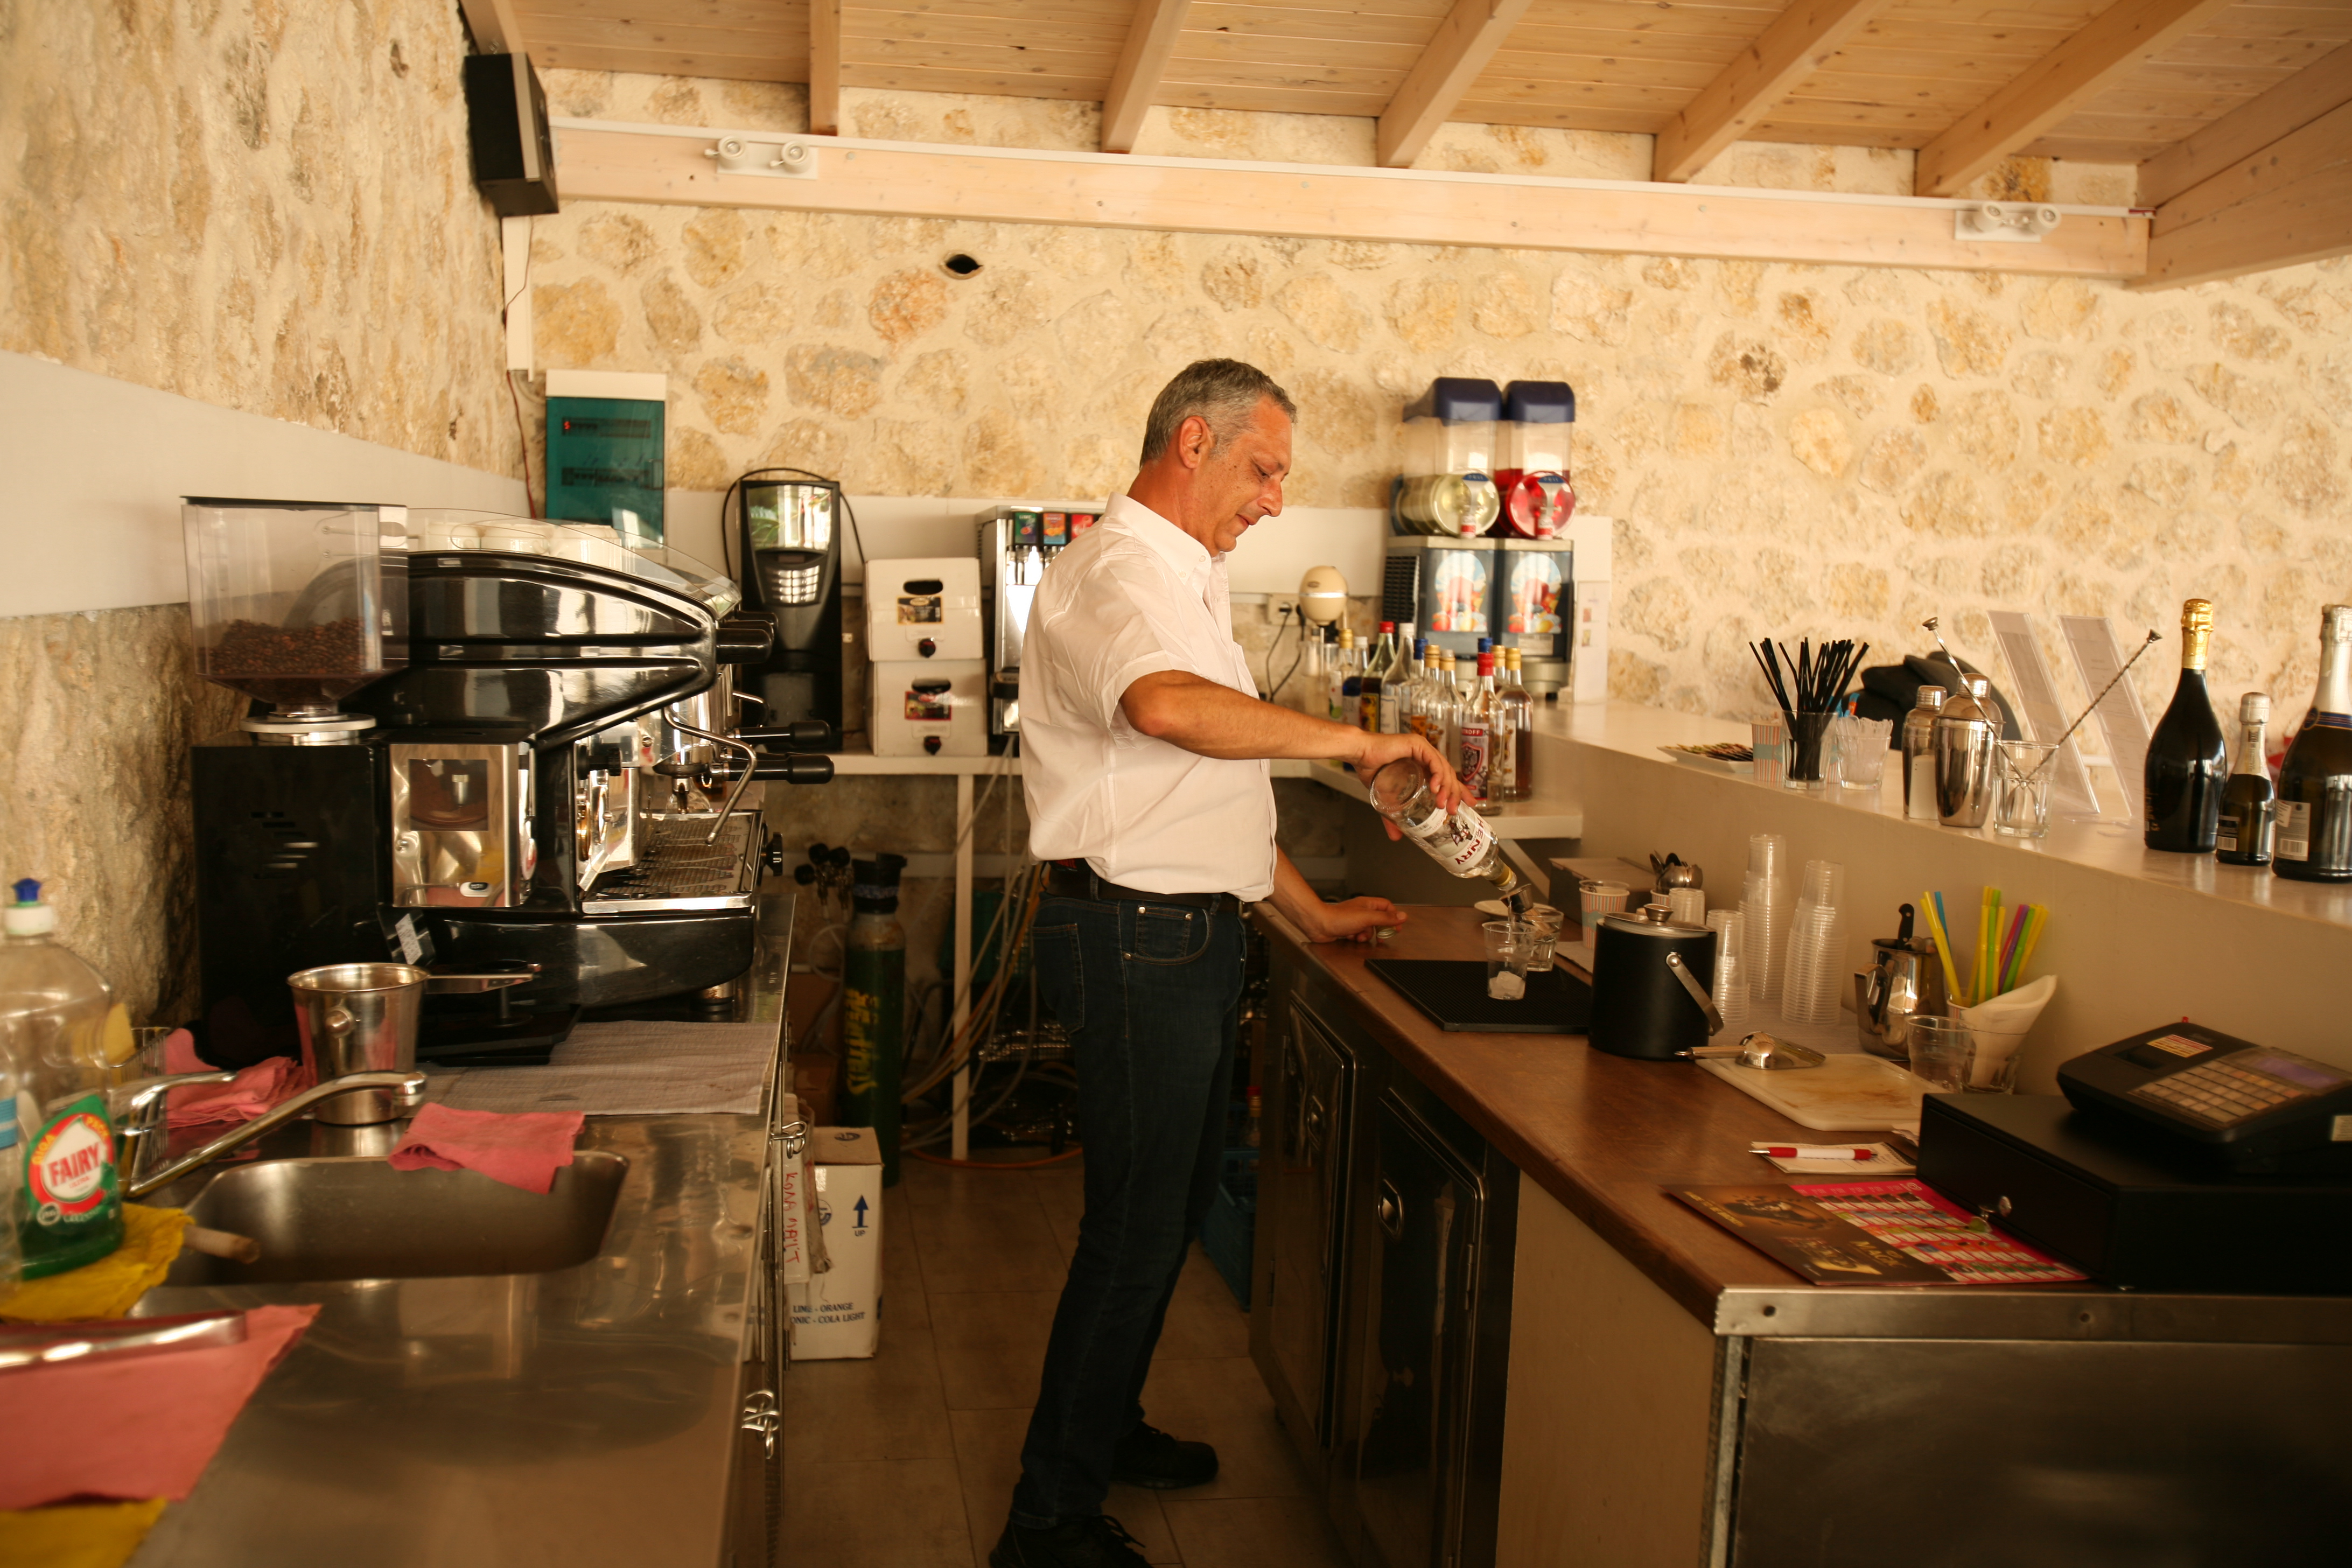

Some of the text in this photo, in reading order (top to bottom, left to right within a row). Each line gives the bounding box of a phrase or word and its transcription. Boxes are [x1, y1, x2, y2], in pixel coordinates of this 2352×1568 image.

[1454, 816, 1485, 865] HENRY
[48, 1142, 100, 1187] FAIRY
[790, 1316, 811, 1324] ONIC
[818, 1314, 840, 1324] COLA
[843, 1312, 865, 1322] LIGHT
[820, 1303, 854, 1312] ORANGE
